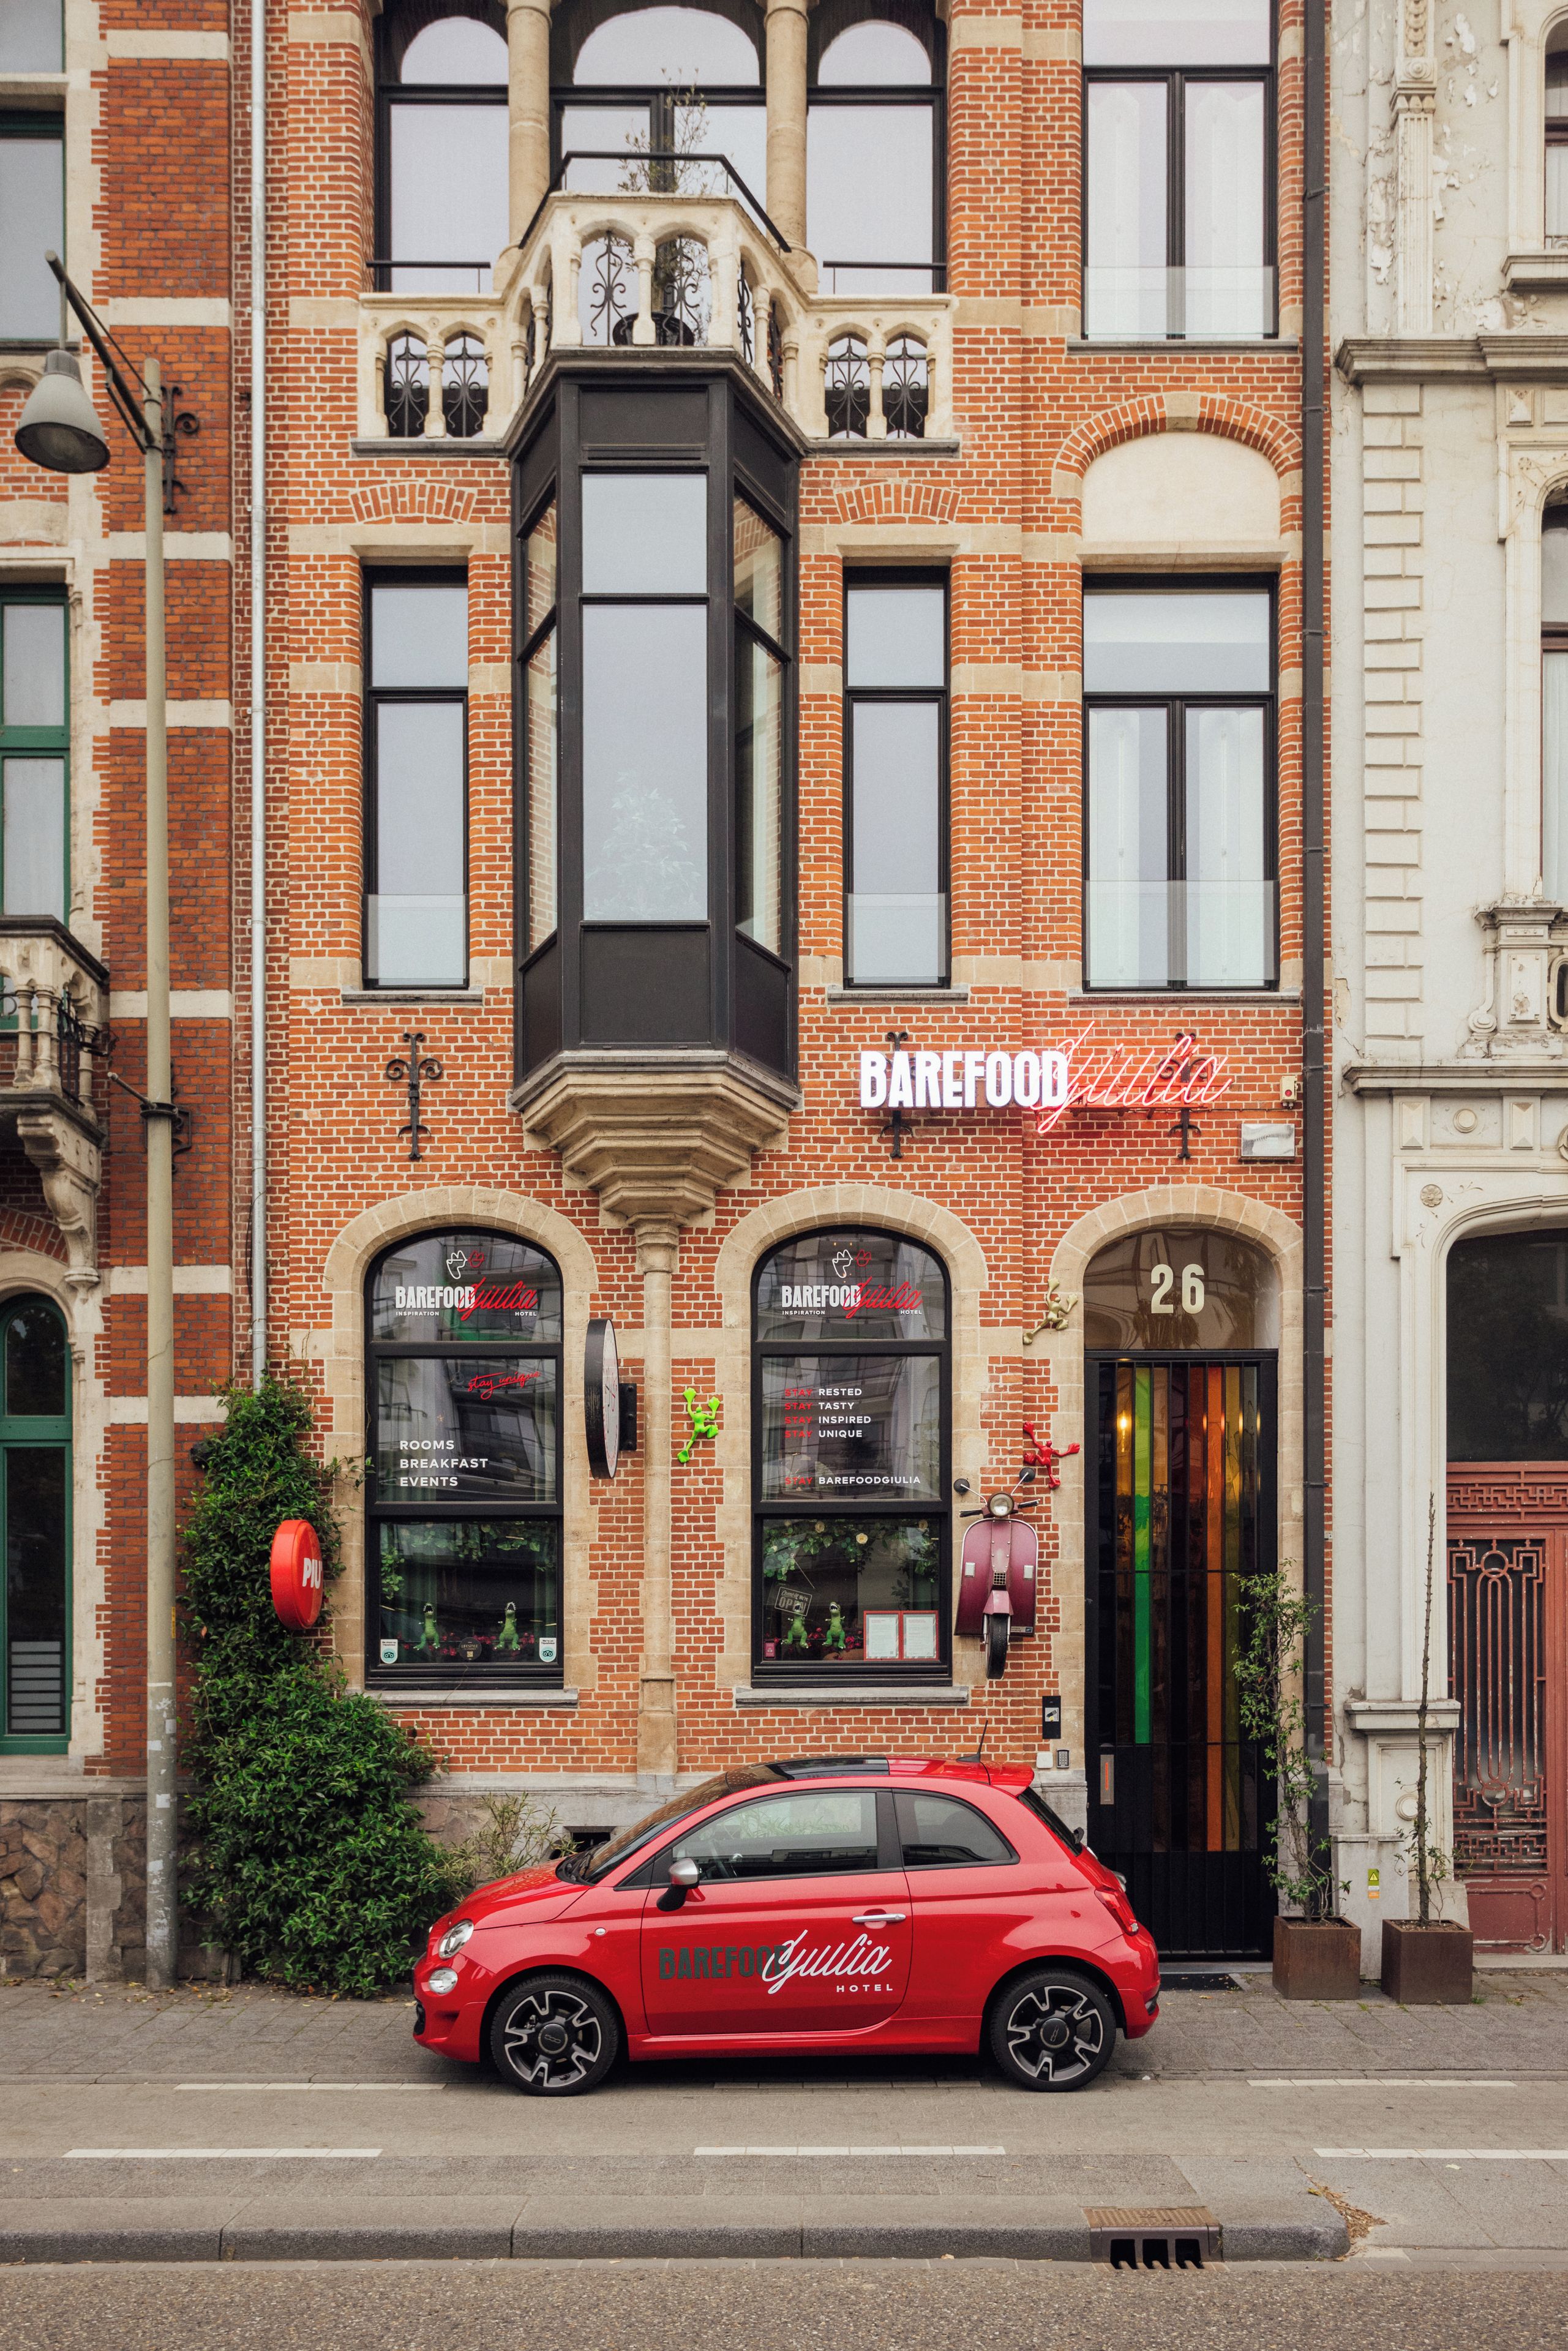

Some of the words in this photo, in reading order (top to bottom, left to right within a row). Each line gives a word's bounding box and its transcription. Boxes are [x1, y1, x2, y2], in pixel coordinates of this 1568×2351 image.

[860, 1050, 1069, 1108] BAREFOOD
[396, 1286, 475, 1308] BAREFOOD
[782, 1285, 861, 1308] BAREFOOD
[1150, 1263, 1204, 1314] 26
[468, 1373, 497, 1400] stay
[400, 1440, 454, 1450] ROOMS
[400, 1458, 489, 1468] BREAKFAST
[400, 1477, 458, 1487] EVENTS
[819, 1476, 921, 1485] BAREFOODGIULIA
[659, 1944, 790, 1980] BAREFOOD
[836, 1984, 893, 1993] HOTEL
